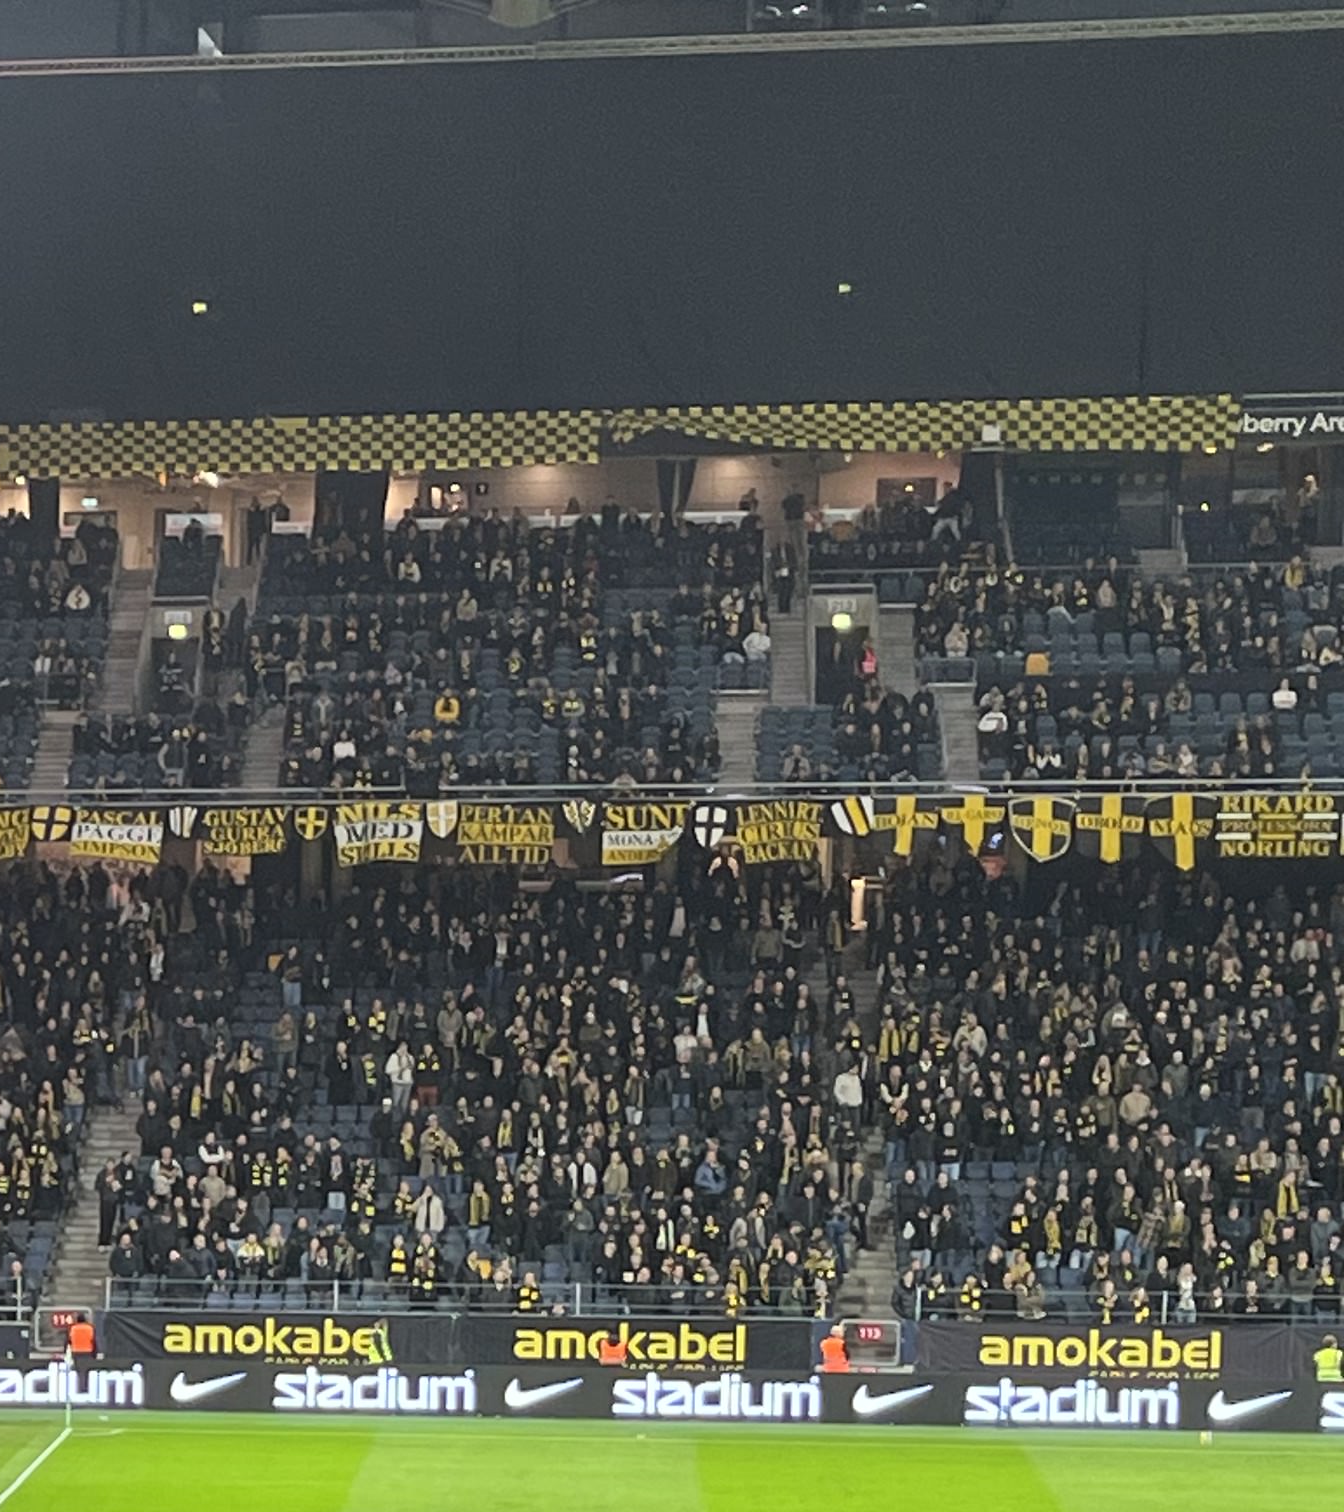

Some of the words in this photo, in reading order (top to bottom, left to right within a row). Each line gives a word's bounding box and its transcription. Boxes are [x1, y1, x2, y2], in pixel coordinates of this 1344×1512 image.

[1235, 413, 1307, 437] berry
[336, 801, 422, 825] NILS
[461, 804, 554, 824] PERTAN
[1220, 795, 1335, 813] RIKARD
[76, 809, 162, 826] PASCAL
[202, 806, 292, 828] GUSTAV
[346, 821, 414, 844] MED
[72, 841, 161, 862] SIMPSON
[459, 844, 550, 865] ALLTID
[1219, 840, 1331, 858] NORLING
[163, 1317, 386, 1355] amokabe
[514, 1322, 747, 1361] amokabel
[979, 1330, 1221, 1367] amokabel
[272, 1366, 477, 1412] stadium
[611, 1371, 820, 1417] stadium
[964, 1377, 1180, 1425] stadium
